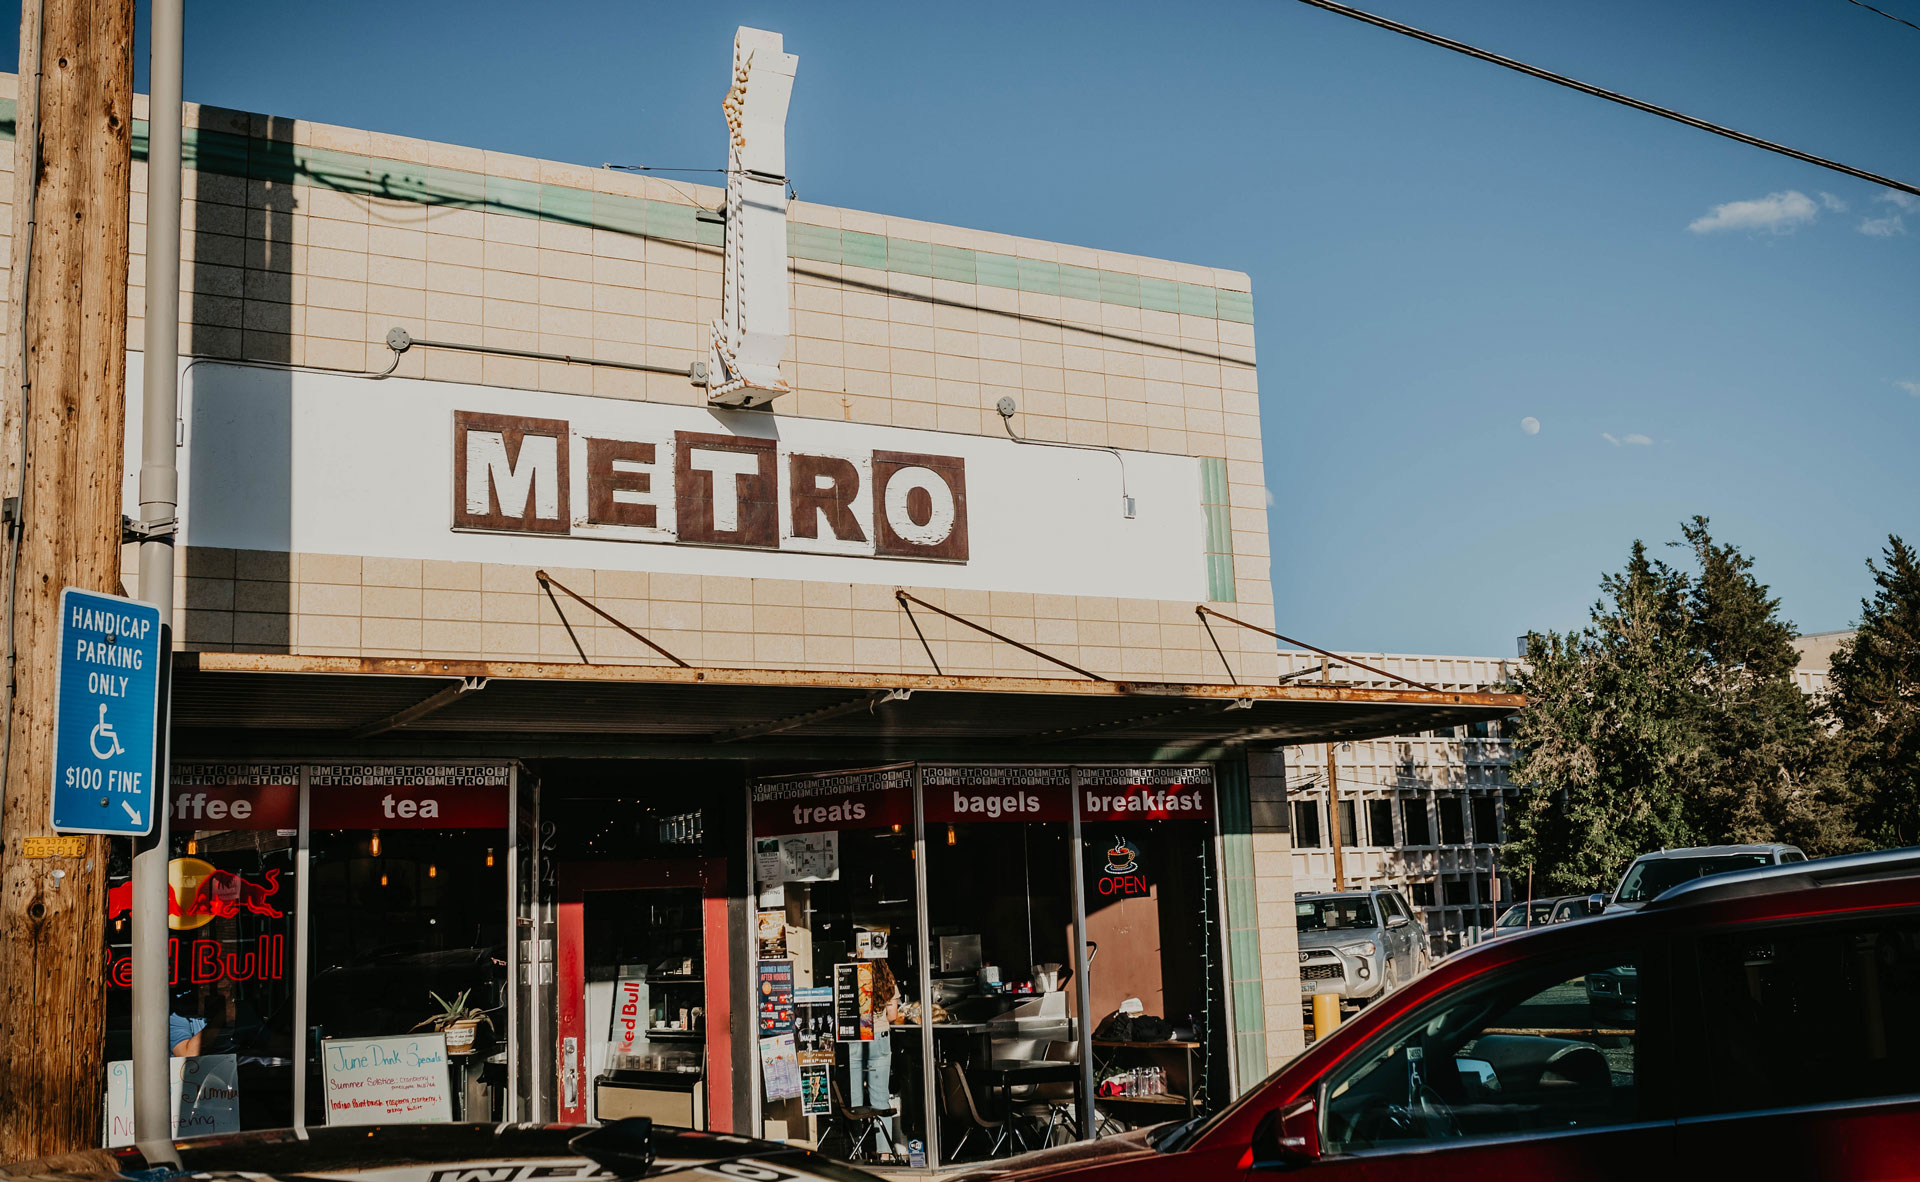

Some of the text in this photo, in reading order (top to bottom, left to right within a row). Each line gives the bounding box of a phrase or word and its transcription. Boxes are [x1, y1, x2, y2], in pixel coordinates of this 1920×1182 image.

[465, 427, 957, 548] METRO
[72, 606, 150, 640] HANDICAP
[77, 639, 143, 670] PARKING
[88, 672, 129, 698] ONLY
[65, 766, 143, 795] $100 FINE
[310, 776, 485, 786] METRO METRO METRO
[321, 767, 497, 776] METRO METRO METRO
[169, 793, 252, 819] ffee
[382, 794, 439, 818] tea
[793, 800, 866, 824] treats
[953, 791, 1040, 818] bagels
[1086, 790, 1203, 812] breakfast
[1098, 875, 1147, 895] OPEN
[191, 934, 283, 983] Bull
[617, 982, 640, 1053] Red Bull
[328, 1045, 369, 1072] June
[365, 1044, 402, 1066] Drink
[330, 1078, 364, 1091] Summer
